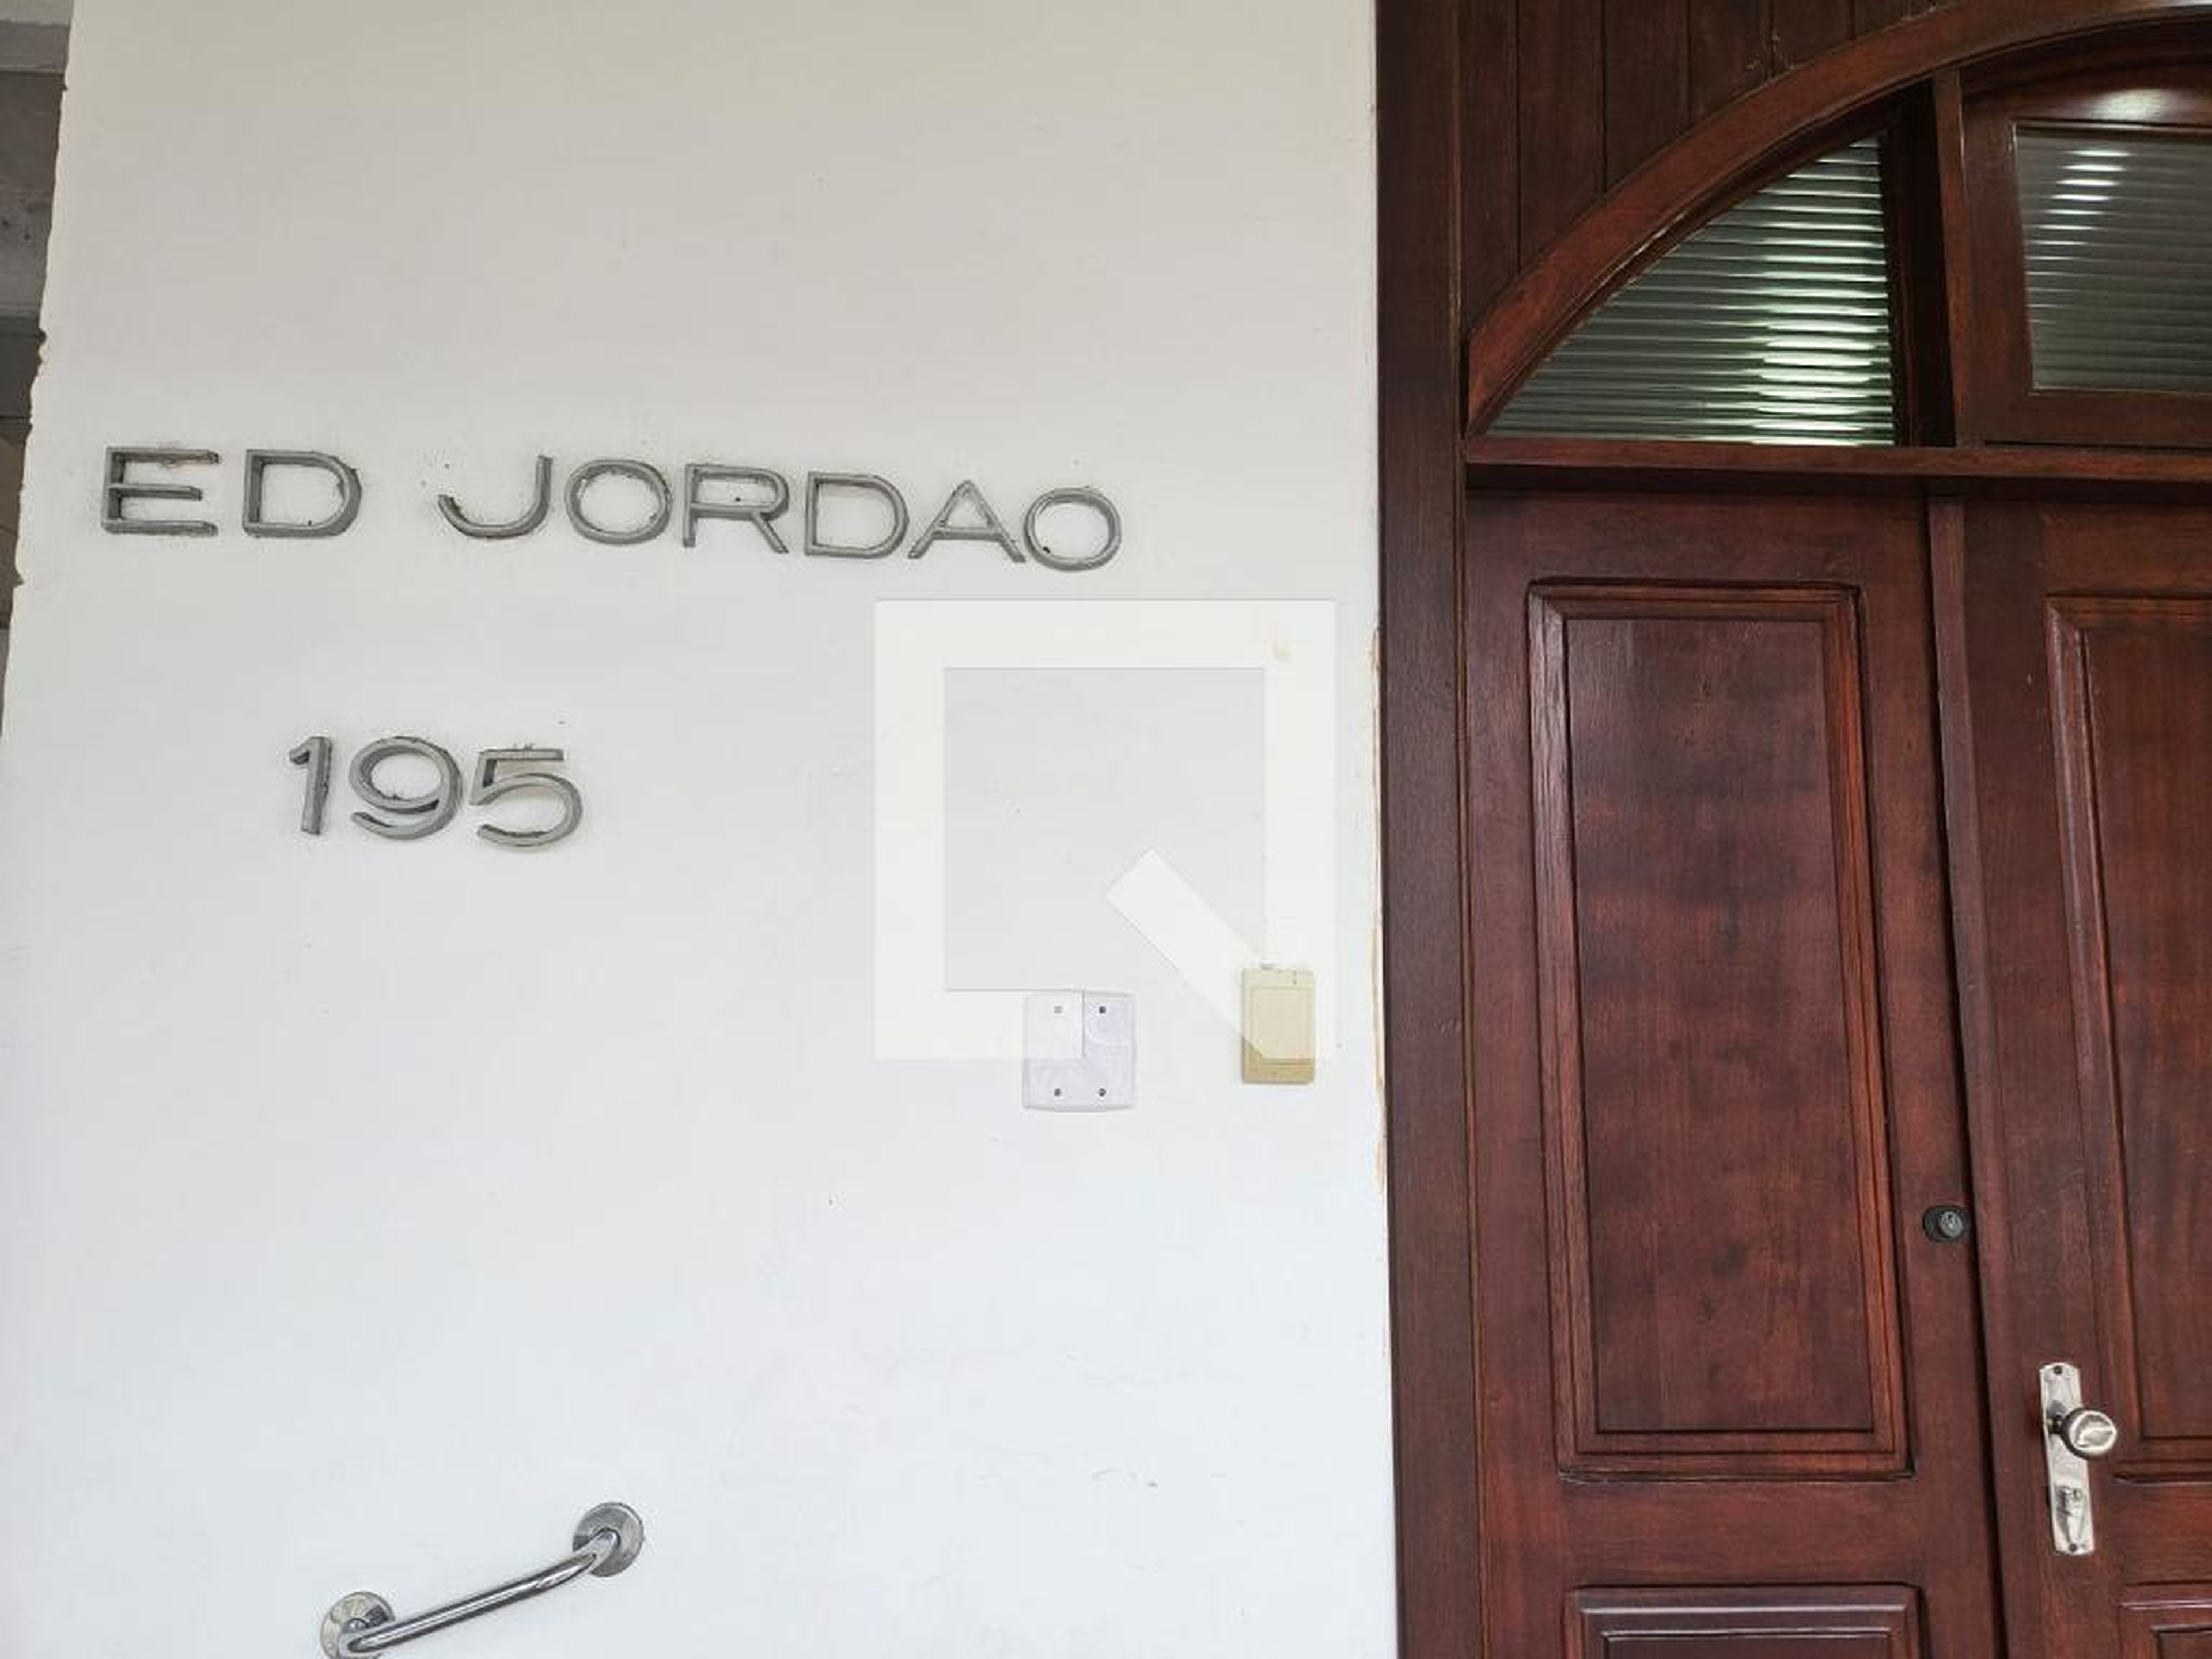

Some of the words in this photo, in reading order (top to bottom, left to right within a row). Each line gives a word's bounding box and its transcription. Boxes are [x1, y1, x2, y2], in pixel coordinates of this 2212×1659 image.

[101, 446, 362, 538] ED
[438, 454, 1122, 572] JORDAO
[289, 735, 582, 847] 195
